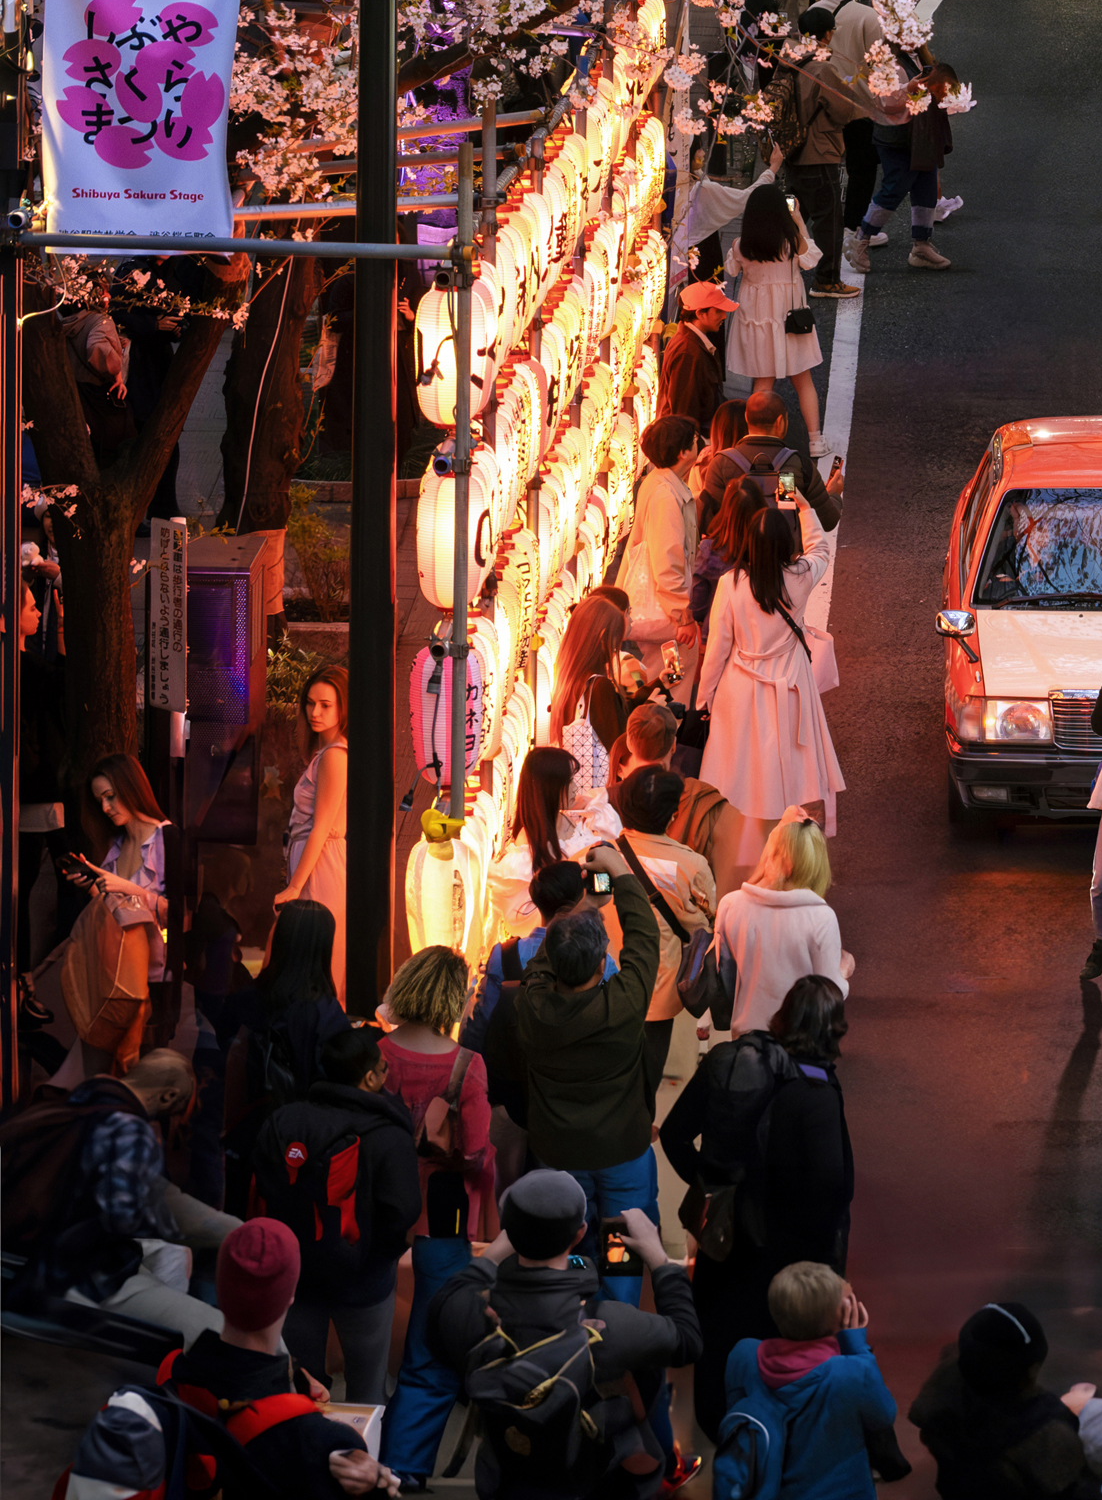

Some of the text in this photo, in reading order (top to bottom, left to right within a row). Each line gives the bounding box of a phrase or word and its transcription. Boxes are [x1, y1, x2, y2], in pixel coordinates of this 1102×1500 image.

[87, 10, 202, 50] しぶや
[82, 56, 189, 102] さくら
[81, 103, 193, 149] まつり
[72, 187, 204, 203] Shibuya Sakura Stage
[288, 1147, 305, 1160] EA
